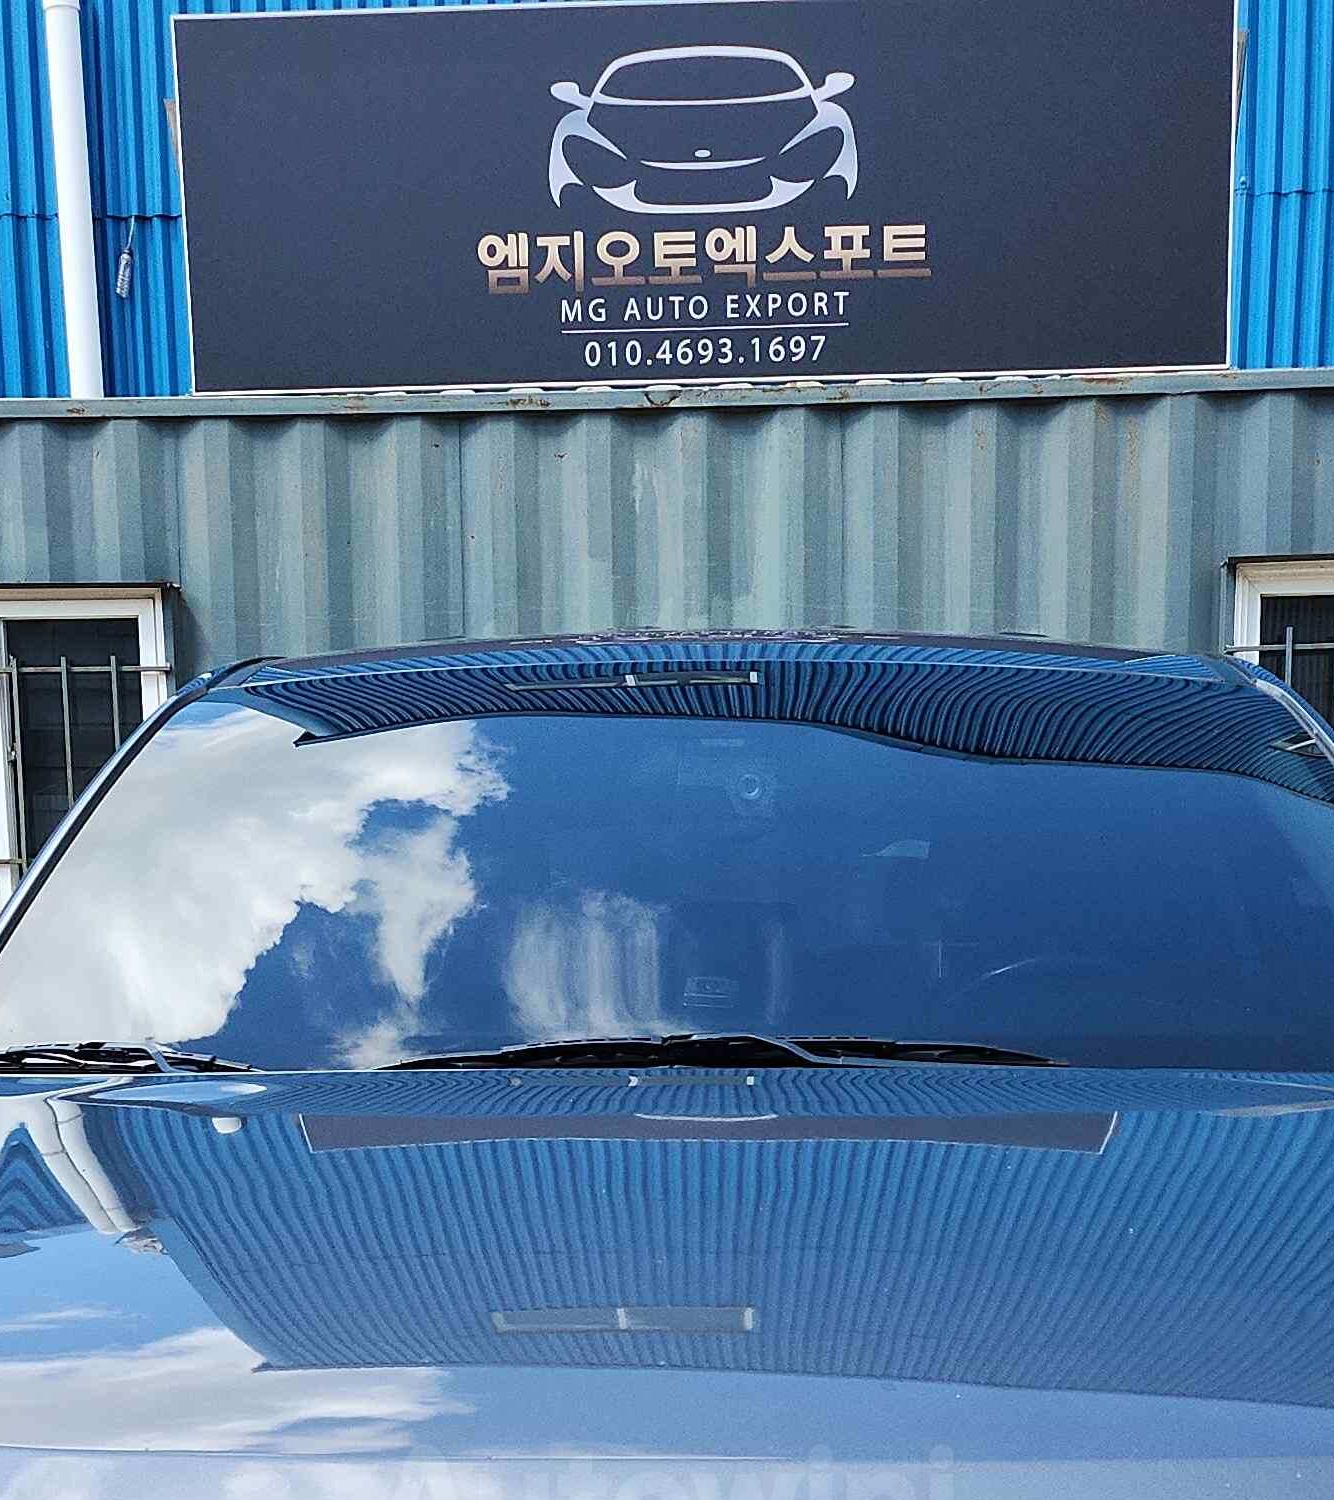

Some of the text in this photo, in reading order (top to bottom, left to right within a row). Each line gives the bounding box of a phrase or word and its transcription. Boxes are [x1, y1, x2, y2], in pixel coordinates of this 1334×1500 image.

[477, 224, 932, 295] 엠지오토엑스포트
[561, 291, 850, 322] MG AUTO EXPORT
[584, 335, 827, 367] 010.4693.1697
